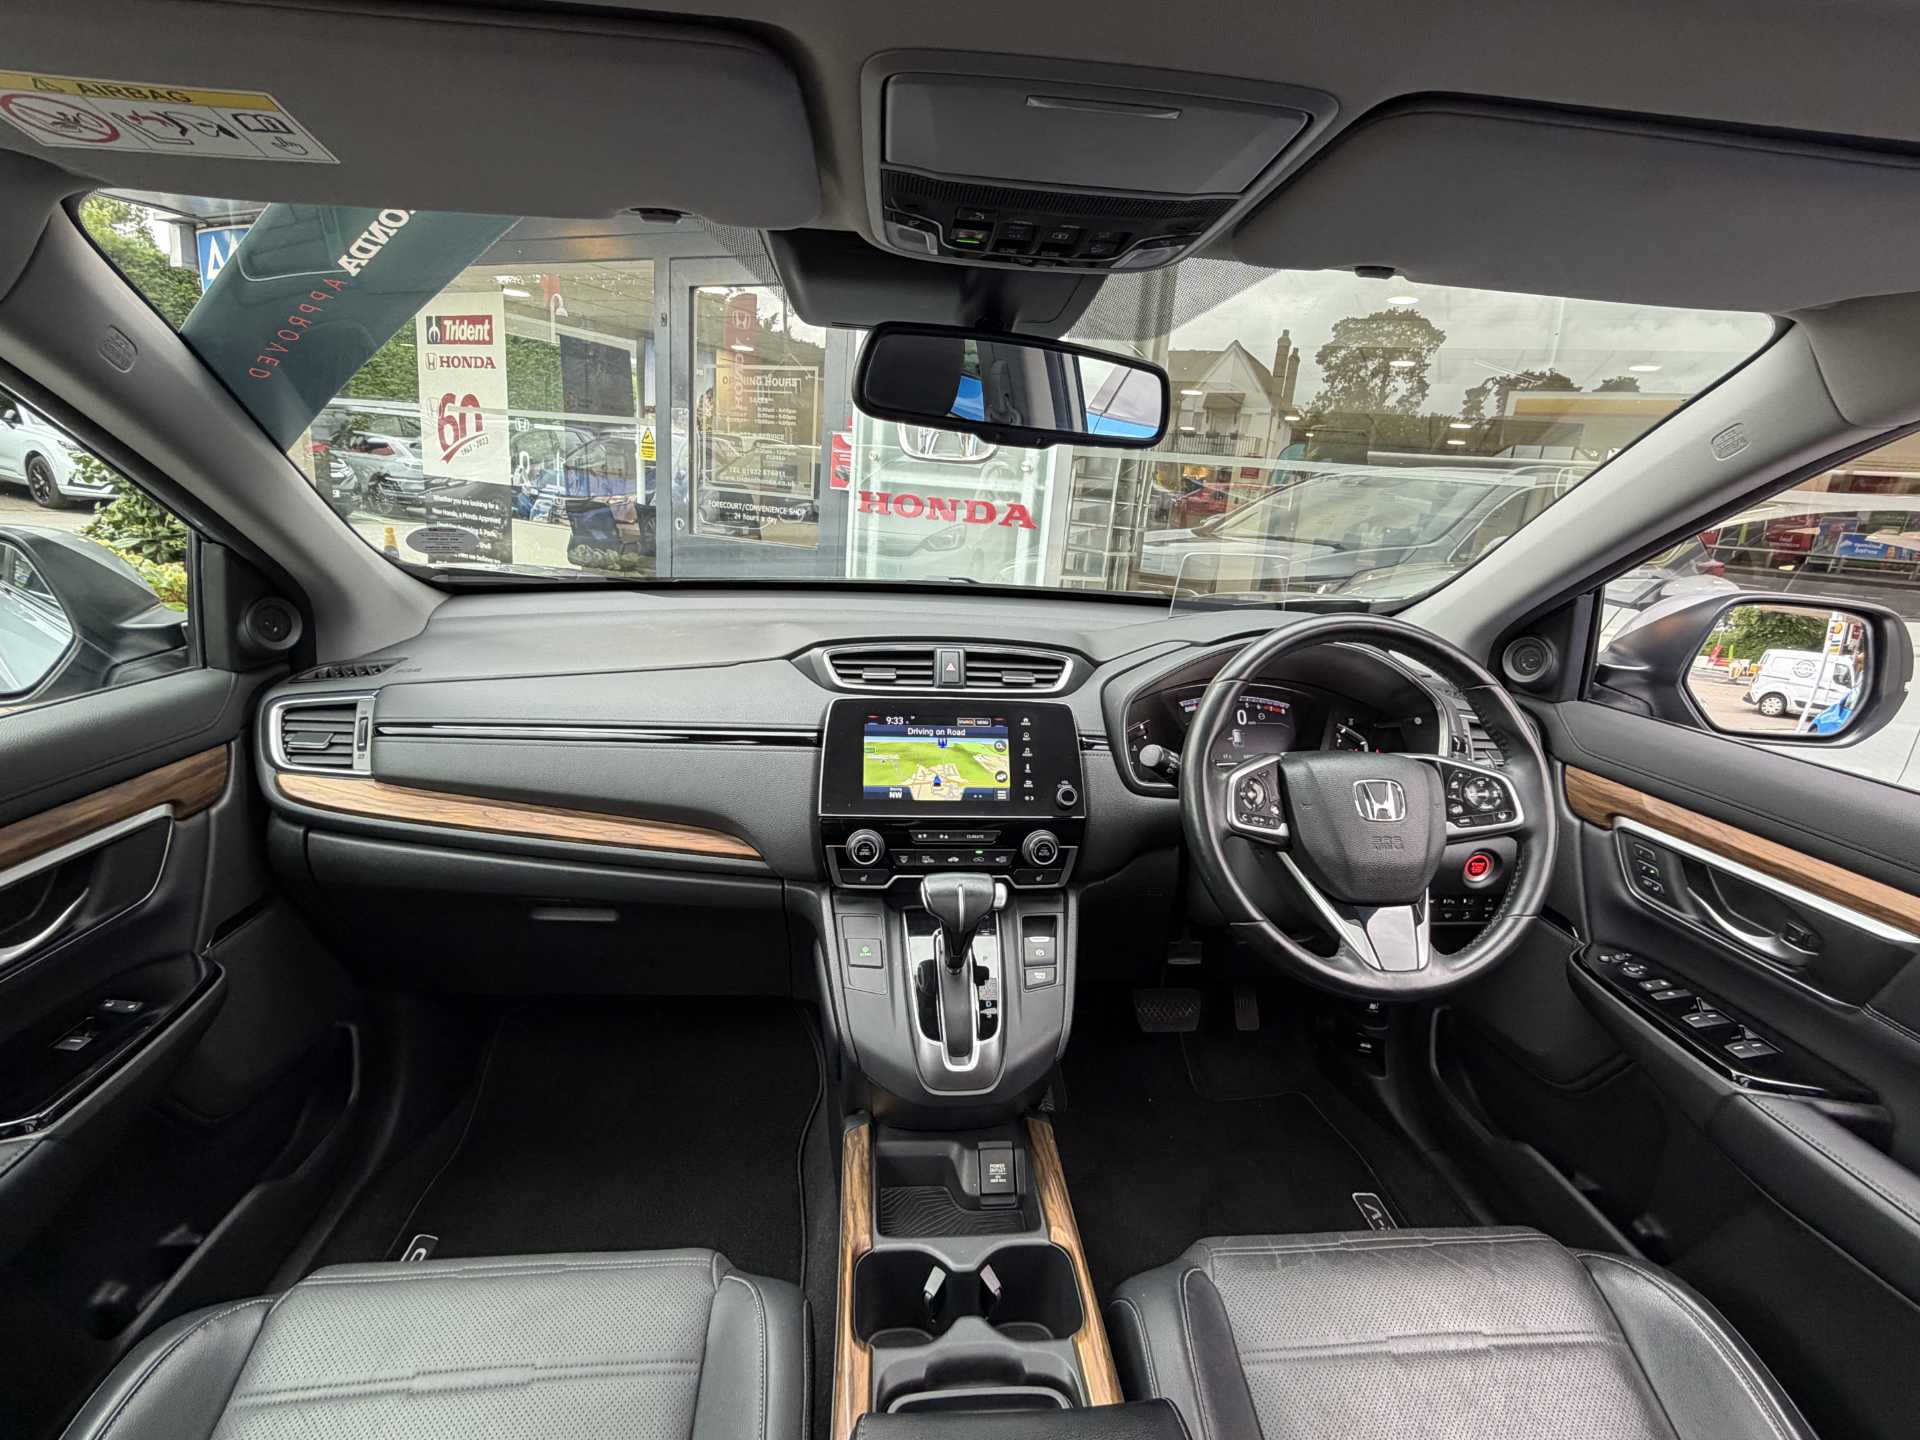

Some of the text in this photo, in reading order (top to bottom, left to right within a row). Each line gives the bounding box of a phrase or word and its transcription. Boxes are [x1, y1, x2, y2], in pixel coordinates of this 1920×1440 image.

[75, 81, 193, 104] AIRBAG
[443, 319, 491, 343] Trident
[438, 355, 496, 370] HONDA
[765, 377, 798, 388] HOURS
[858, 490, 1039, 531] HONDA
[886, 716, 904, 725] 9:33
[1237, 709, 1247, 725] 0
[907, 727, 933, 736] Driving
[946, 728, 966, 736] Road
